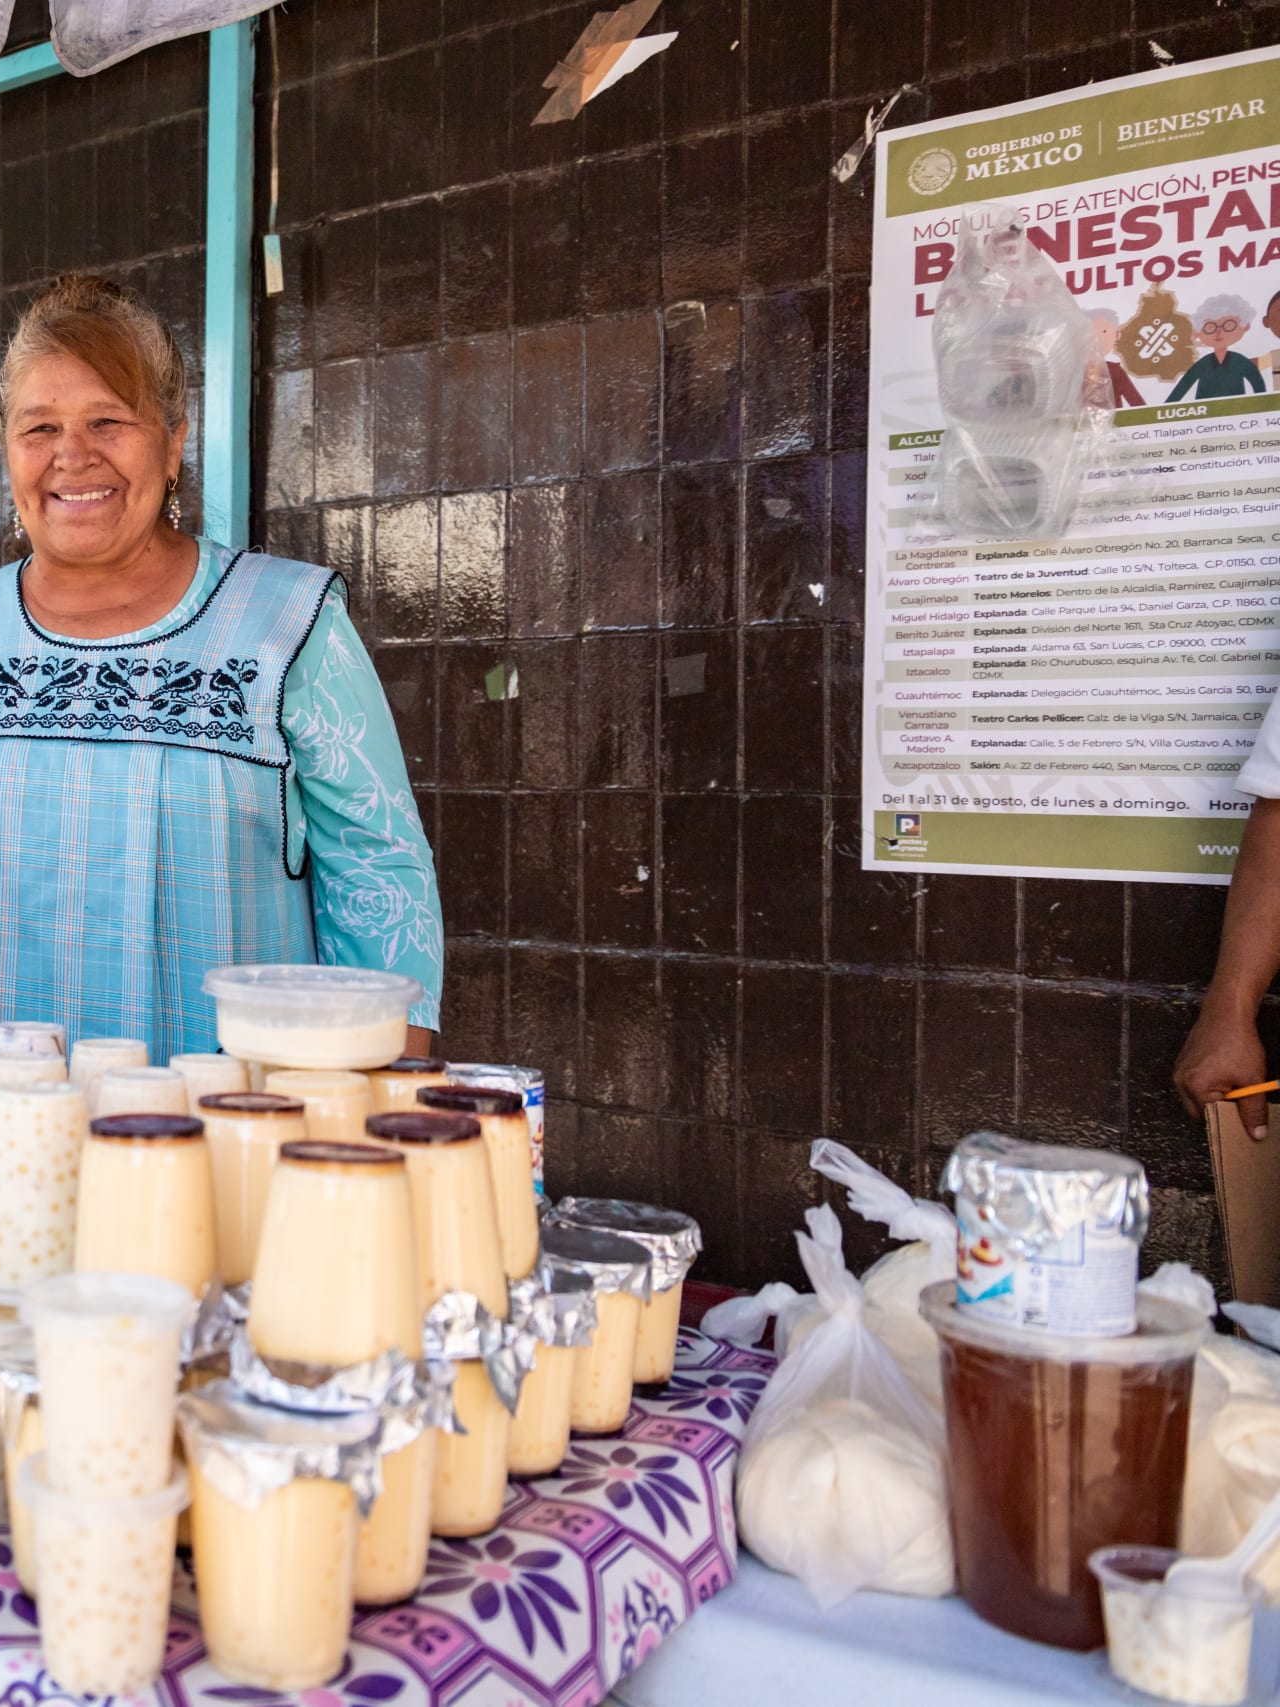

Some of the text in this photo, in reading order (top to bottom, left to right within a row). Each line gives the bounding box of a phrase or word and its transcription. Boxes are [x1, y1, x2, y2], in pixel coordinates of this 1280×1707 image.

[1117, 98, 1266, 142] BIENESTAR
[965, 125, 1083, 159] GOBIERNO DE
[965, 142, 1083, 181] MÉXICO
[1036, 199, 1068, 221] DE
[1073, 174, 1206, 214] ATENCIÓN,
[1156, 405, 1208, 420] LUGAR
[1132, 430, 1152, 440] Col.
[1153, 427, 1193, 439] Tlalpan
[1196, 422, 1236, 433] Centro,
[1239, 419, 1260, 430] C.P.
[1170, 447, 1188, 456] No.
[1190, 446, 1197, 454] 4
[1201, 442, 1236, 453] Barrio,
[1239, 440, 1249, 449] El
[1180, 457, 1253, 472] Constitución,
[1197, 487, 1230, 499] Barrio
[1234, 486, 1243, 496] la
[1134, 512, 1151, 522] Av.
[1154, 509, 1191, 521] Miguel
[1193, 506, 1239, 518] Hidalgo,
[895, 549, 968, 561] La Magdalena
[975, 550, 1030, 561] Explanada:
[1033, 548, 1058, 557] Calle
[1095, 541, 1142, 554] Obregón
[1145, 541, 1161, 550] No.
[1165, 540, 1180, 549] 20,
[1183, 537, 1233, 548] Barranca
[1236, 535, 1265, 545] Seca,
[905, 560, 956, 571] Contreras
[975, 562, 1199, 581] Teatro de la Juventud: Calle 10 S/N, Tolteca,
[888, 574, 969, 587] Álvaro Obregón
[974, 591, 1007, 600] Teatro
[1010, 589, 1053, 599] Morelos:
[1056, 587, 1092, 597] Dentro
[1095, 585, 1108, 595] de
[1110, 585, 1119, 594] la
[1122, 582, 1166, 593] Alcaldía,
[900, 594, 959, 606] Cuajimalpa
[974, 608, 1029, 619] Explanada:
[1031, 607, 1056, 616] Calle
[1059, 606, 1096, 617] Parque
[1099, 604, 1118, 613] Lira
[1120, 604, 1136, 613] 94,
[1139, 602, 1174, 612] Daniel
[1176, 601, 1209, 611] Garza,
[1212, 599, 1232, 609] C.P.
[892, 612, 970, 625] Miguel Hidalgo
[973, 626, 1028, 637] Explanada:
[1031, 624, 1071, 634] División
[1073, 623, 1090, 632] del
[1092, 622, 1121, 631] Norte
[1148, 621, 1166, 629] Sta
[1168, 620, 1193, 629] Cruz
[1195, 618, 1236, 629] Atoyac,
[1238, 616, 1276, 626] CDMX
[895, 629, 966, 639] Benito Juárez
[903, 647, 956, 657] Iztapalapa
[973, 636, 1247, 655] Explanada: Aldama San Lucas, C.P. 09000, CDMX
[972, 660, 1027, 671] Explanada:
[1049, 657, 1115, 668] Churubusco,
[1117, 655, 1160, 666] esquina
[1161, 654, 1178, 664] Av.
[1198, 652, 1217, 662] Col.
[1220, 651, 1261, 662] Gabriel
[906, 667, 951, 676] Iztacalco
[972, 671, 1004, 680] CDMX
[895, 691, 962, 701] Cuauhtémoc
[972, 685, 1252, 700] Explanada: Delegación Cuauhtémoc, Jesús García 50,
[898, 710, 957, 719] Venustiano
[971, 715, 1005, 723] Teatro
[1007, 714, 1040, 723] Carlos
[1042, 714, 1084, 723] Pellicer:
[1113, 713, 1127, 722] de
[1129, 712, 1138, 721] la
[1141, 713, 1165, 724] Viga
[1191, 712, 1240, 722] Jamaica,
[904, 721, 949, 730] Carranza
[900, 734, 941, 743] Gustavo
[970, 739, 1027, 749] Explanada:
[1058, 739, 1065, 747] 5
[1067, 739, 1080, 748] de
[1082, 739, 1122, 748] Febrero
[1149, 739, 1172, 748] Villa
[1174, 739, 1219, 748] Gustavo
[906, 745, 946, 754] Madero
[893, 761, 961, 771] Azcapotzalco
[970, 761, 1240, 772] Salón: Av. 22 de Febrero 440, San Marcos, C.P. 02020
[882, 794, 1190, 812] Del 1 al 31 de agosto, de lunes a domingo.
[901, 818, 915, 833] P
